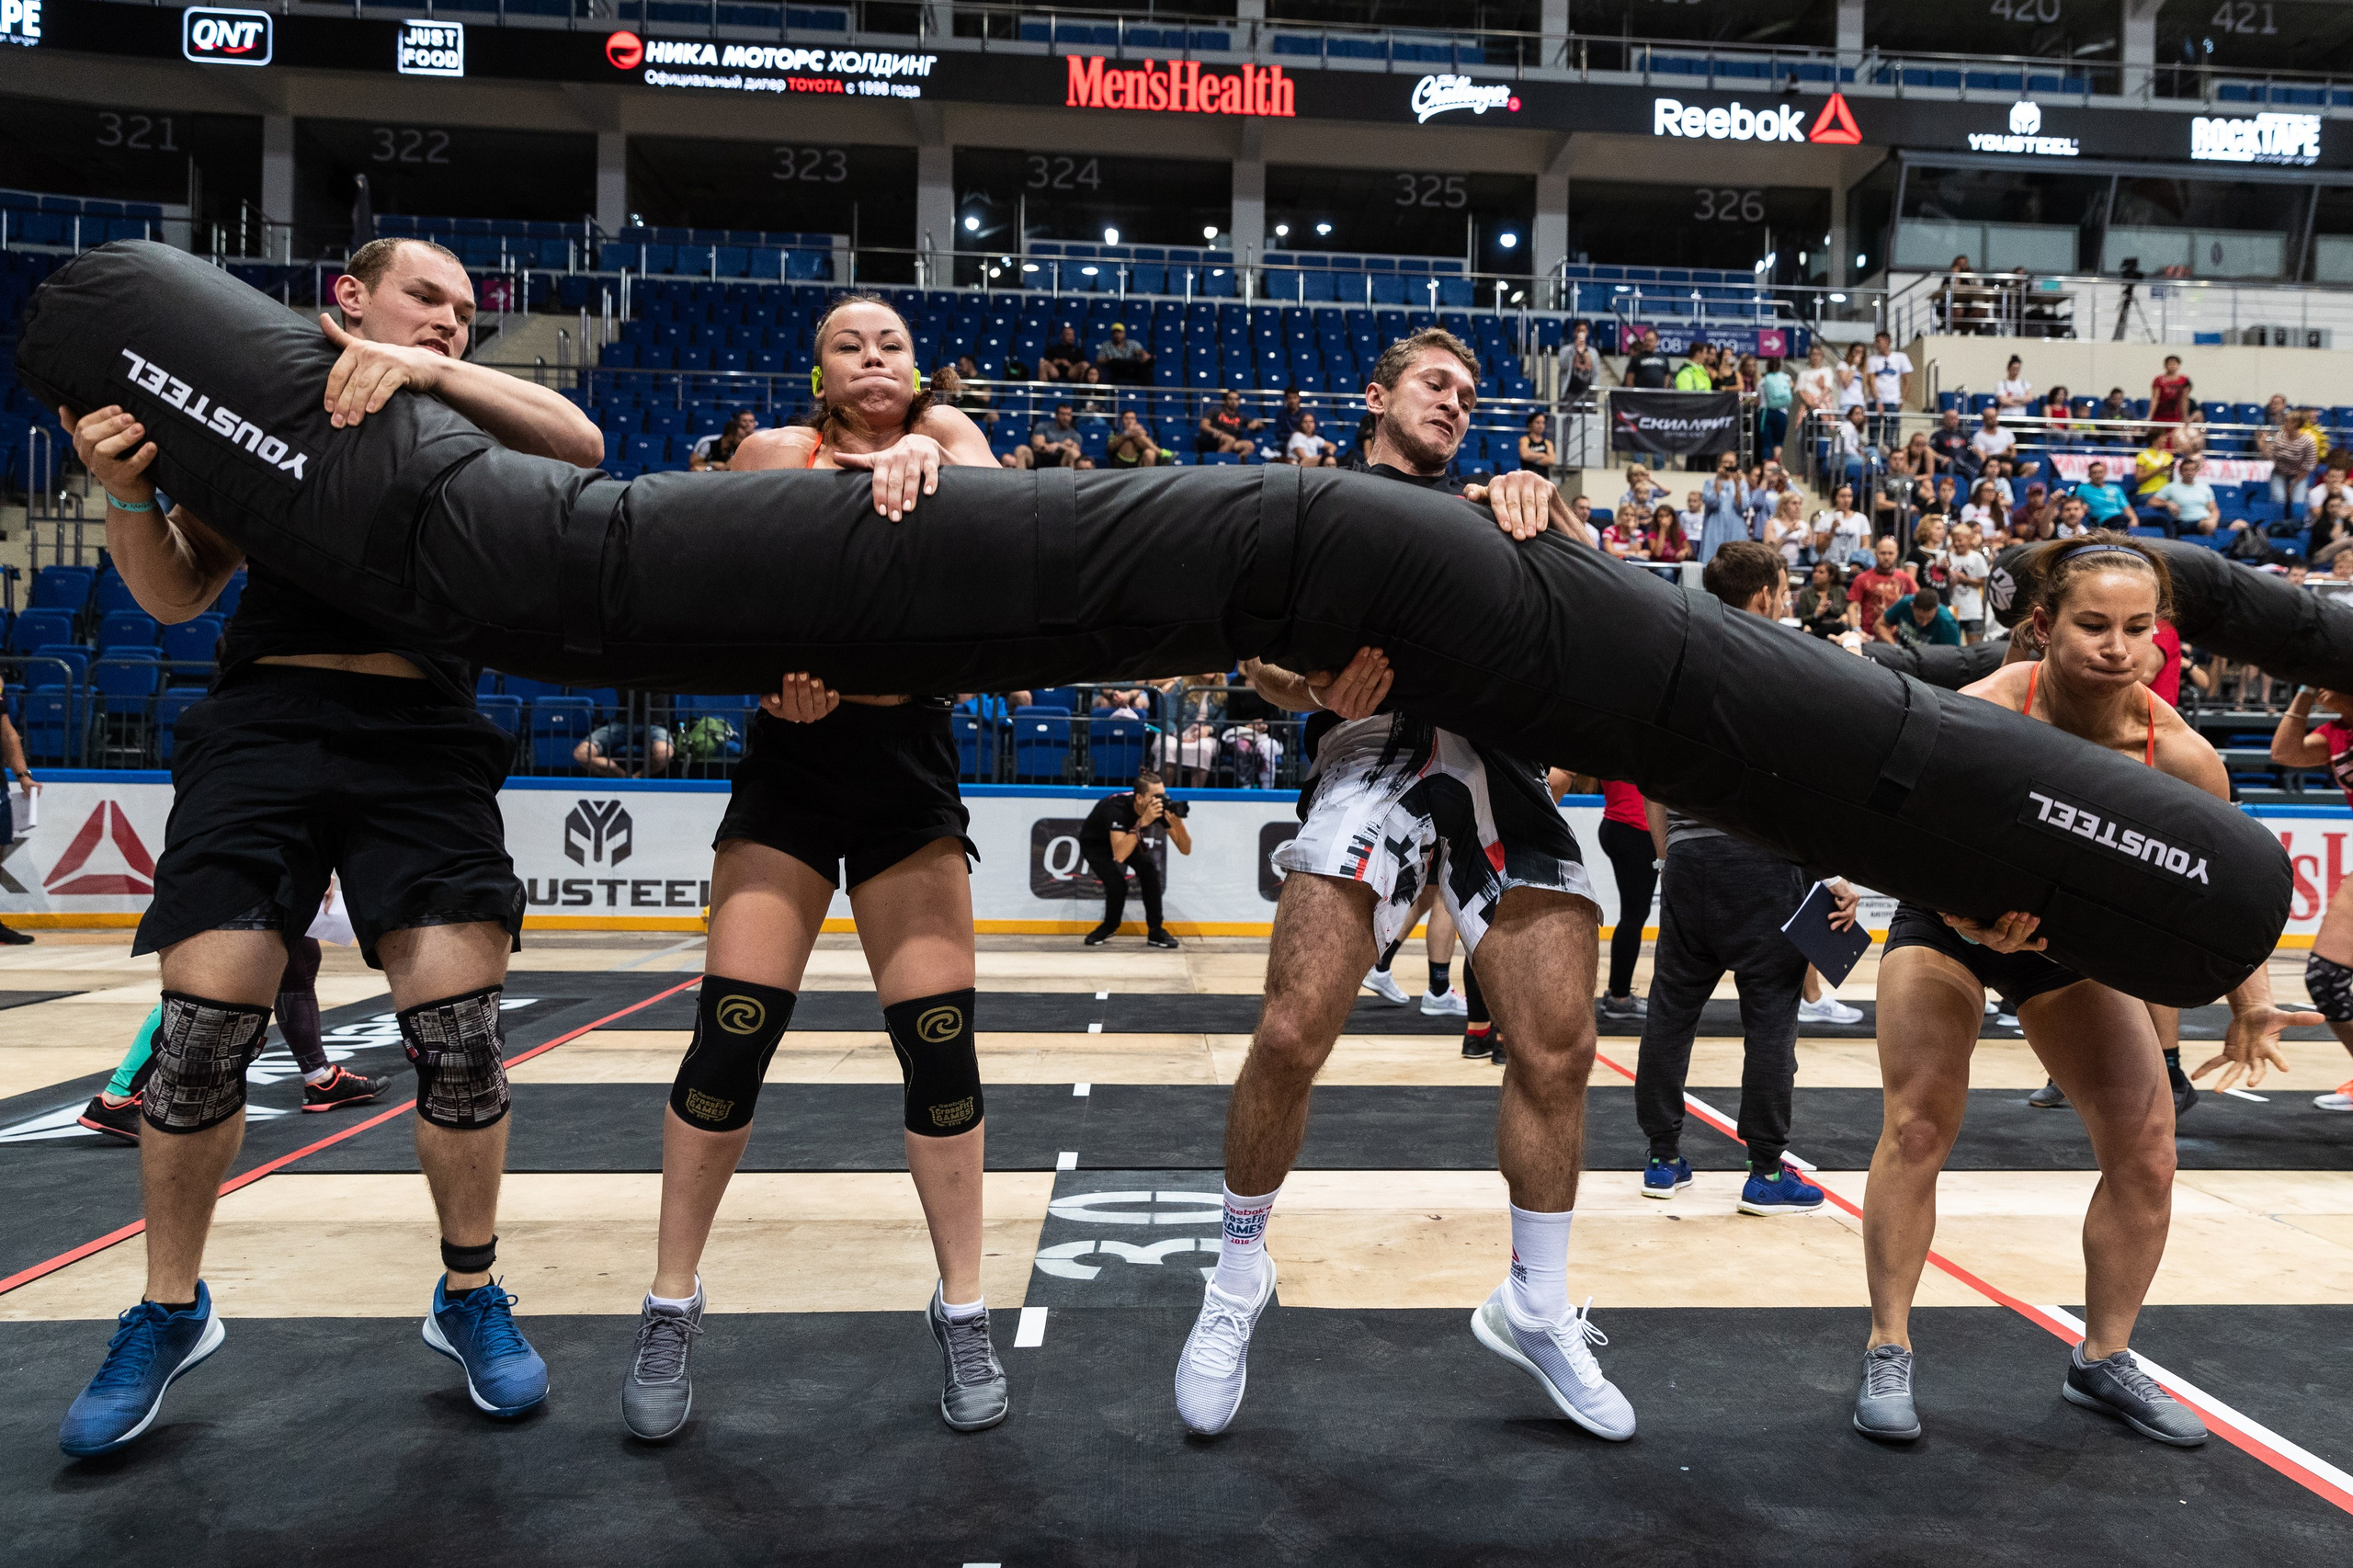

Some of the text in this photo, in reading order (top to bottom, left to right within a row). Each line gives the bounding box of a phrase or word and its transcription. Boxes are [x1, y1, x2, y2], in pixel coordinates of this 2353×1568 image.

[1, 0, 41, 37] PE
[1990, 0, 2061, 23] 420
[2211, 1, 2278, 34] 421
[192, 19, 264, 52] QNT
[404, 28, 457, 47] JUST
[404, 49, 459, 69] FOOD
[645, 40, 938, 78] НИКА МОТОРС ХОЛДИНГ
[644, 69, 742, 89] Официальный
[744, 76, 786, 93] дилер
[787, 77, 844, 93] TOYOTA
[858, 80, 889, 97] 1998
[891, 85, 921, 99] года
[97, 112, 179, 152] 321
[1654, 97, 1805, 142] Reebok
[371, 128, 450, 165] 322
[1968, 132, 2079, 156] YOUSTEEL
[2191, 115, 2321, 158] ROCKTAPE
[772, 147, 848, 182] 323
[1026, 156, 1102, 190] 324
[1394, 174, 1468, 209] 325
[1694, 187, 1765, 222] 326
[121, 348, 309, 481] YOUSTEEL
[2029, 791, 2210, 885] YOUSTEEL
[527, 878, 710, 907] USTEE
[169, 1015, 194, 1056] ROCKTAPE
[153, 1082, 176, 1119] ROCKTAPE
[689, 1100, 725, 1116] GAMES
[691, 1093, 727, 1110] CrossFit
[697, 1090, 726, 1104] Reebok
[935, 1102, 970, 1115] CrossFit
[938, 1098, 966, 1108] Reebok
[936, 1108, 971, 1121] GAMES
[1230, 1237, 1250, 1245] 2018
